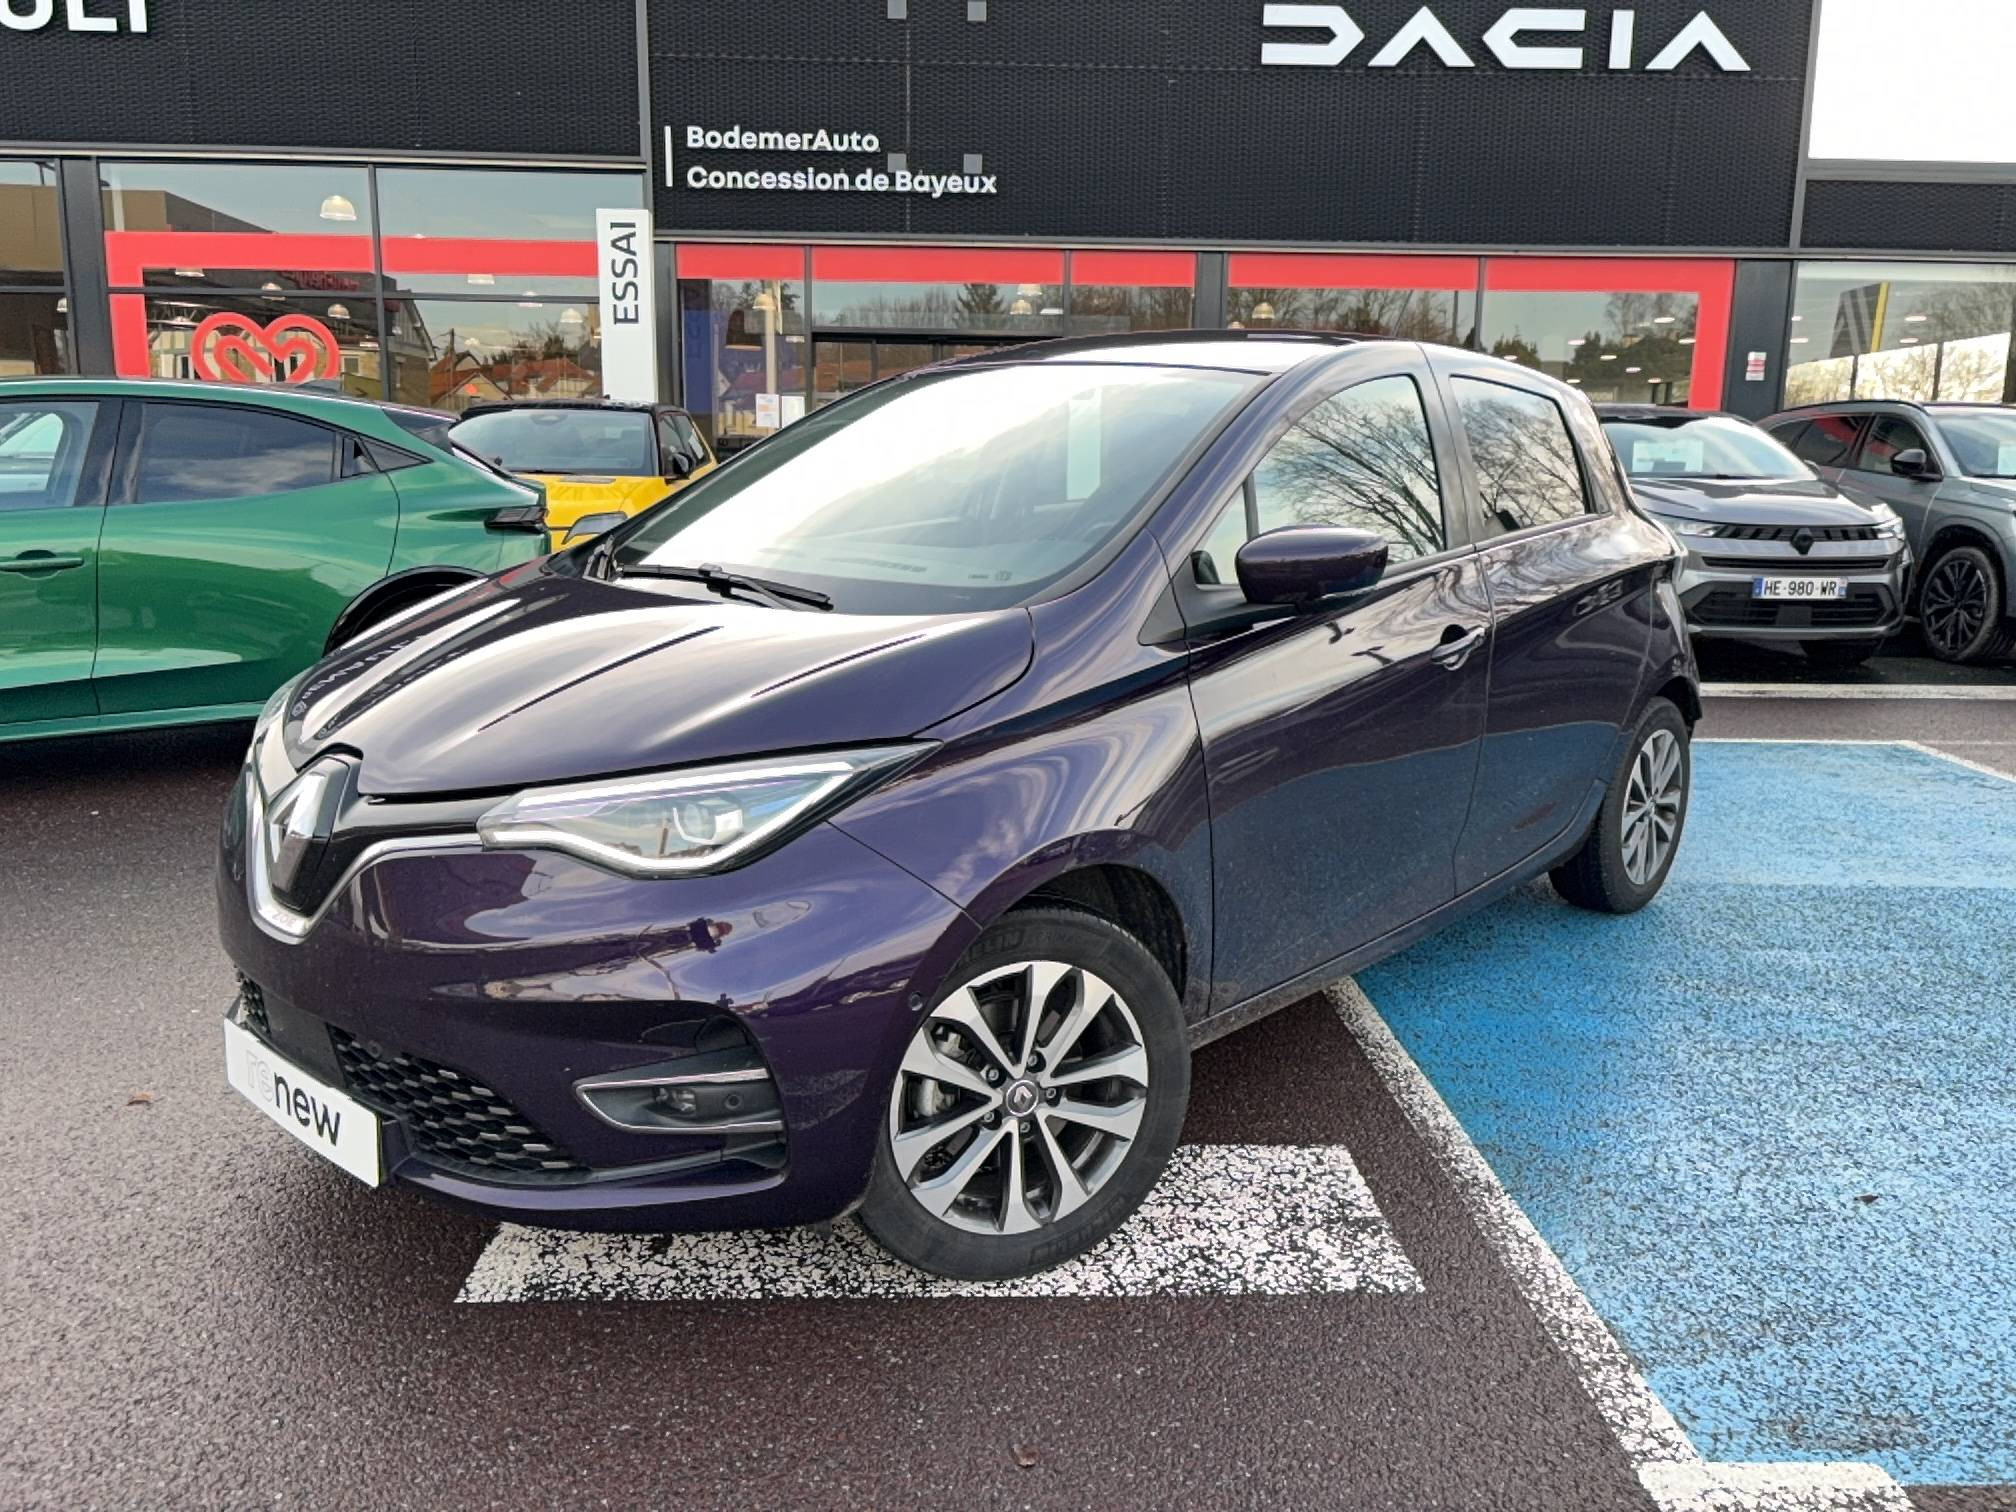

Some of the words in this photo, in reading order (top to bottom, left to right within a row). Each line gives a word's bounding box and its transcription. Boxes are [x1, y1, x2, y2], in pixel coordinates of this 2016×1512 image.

[1260, 5, 1752, 72] DACIA
[686, 125, 881, 152] BodemerAuto
[686, 165, 850, 191] Concession
[854, 168, 890, 191] de
[894, 170, 998, 198] Bayeux
[610, 222, 639, 325] ESSAI
[1764, 580, 1837, 596] HE-980-WR
